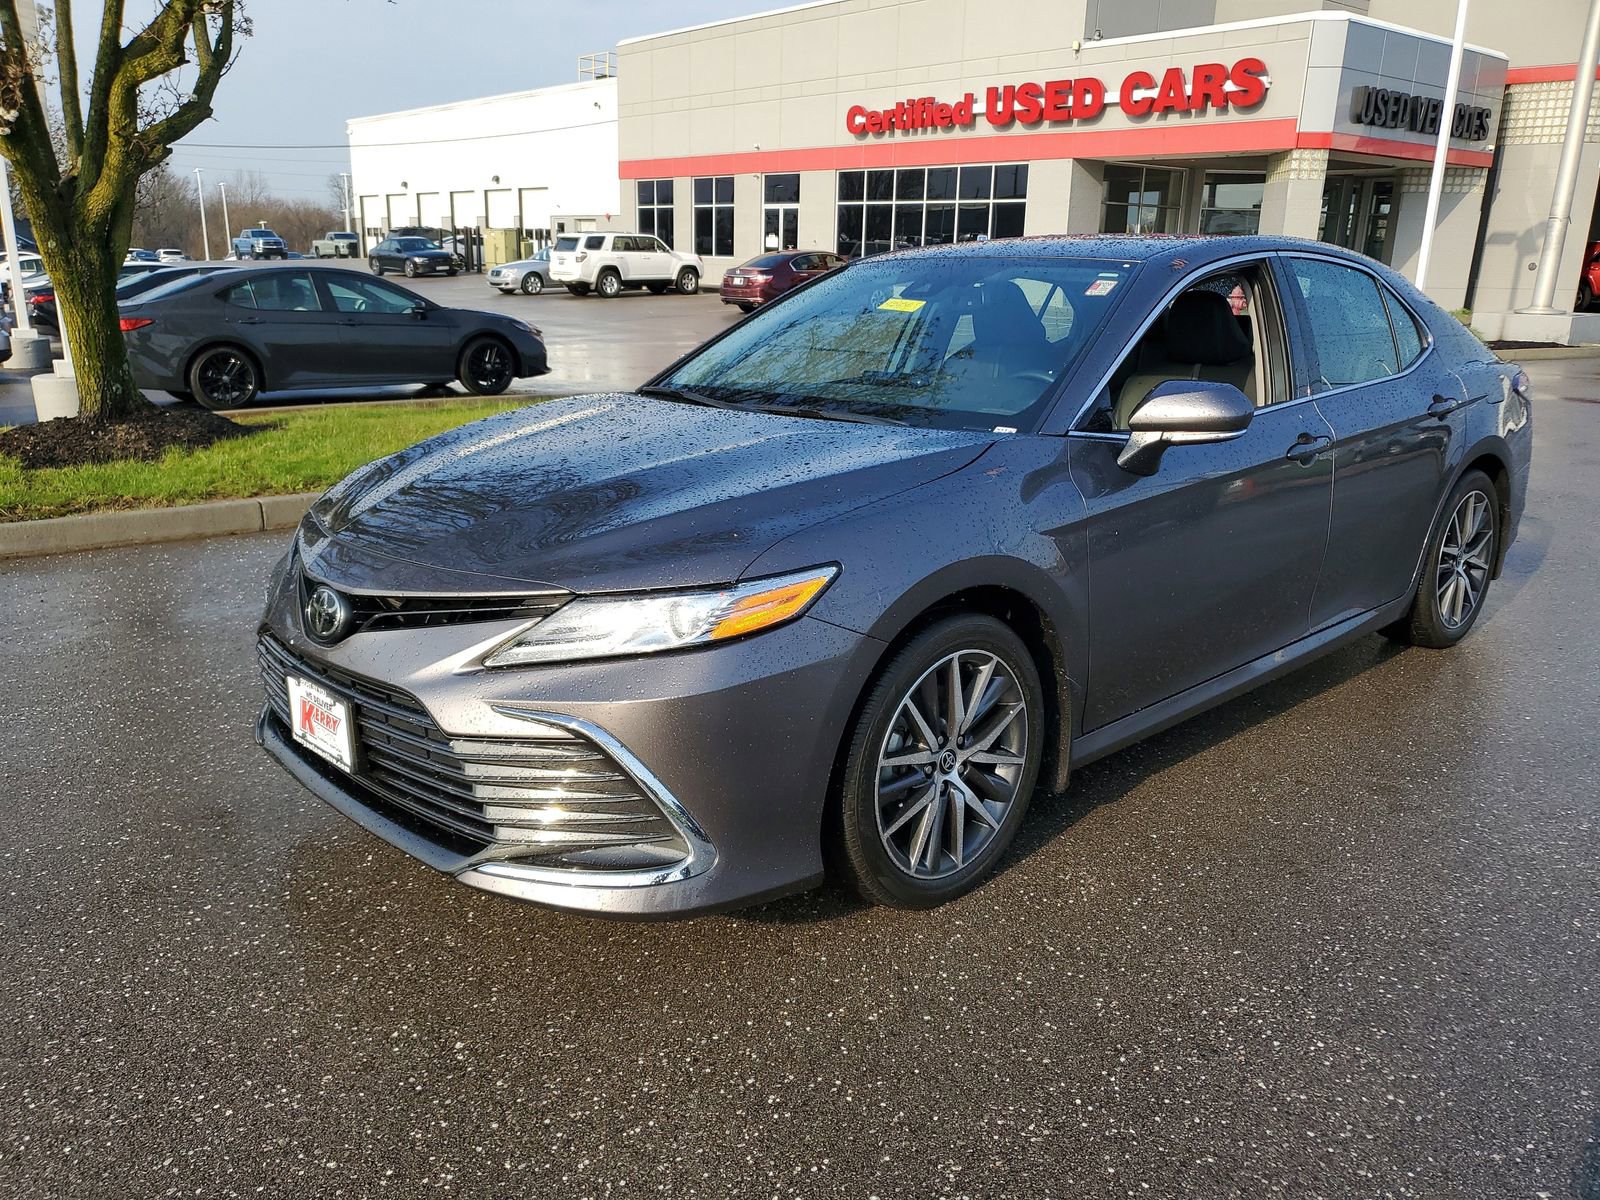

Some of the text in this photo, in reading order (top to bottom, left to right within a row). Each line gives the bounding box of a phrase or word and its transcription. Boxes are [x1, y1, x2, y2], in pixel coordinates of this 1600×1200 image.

[846, 56, 1270, 135] Certified USED CARS
[1353, 85, 1492, 141] USED VECLES
[301, 698, 341, 736] KERRY
